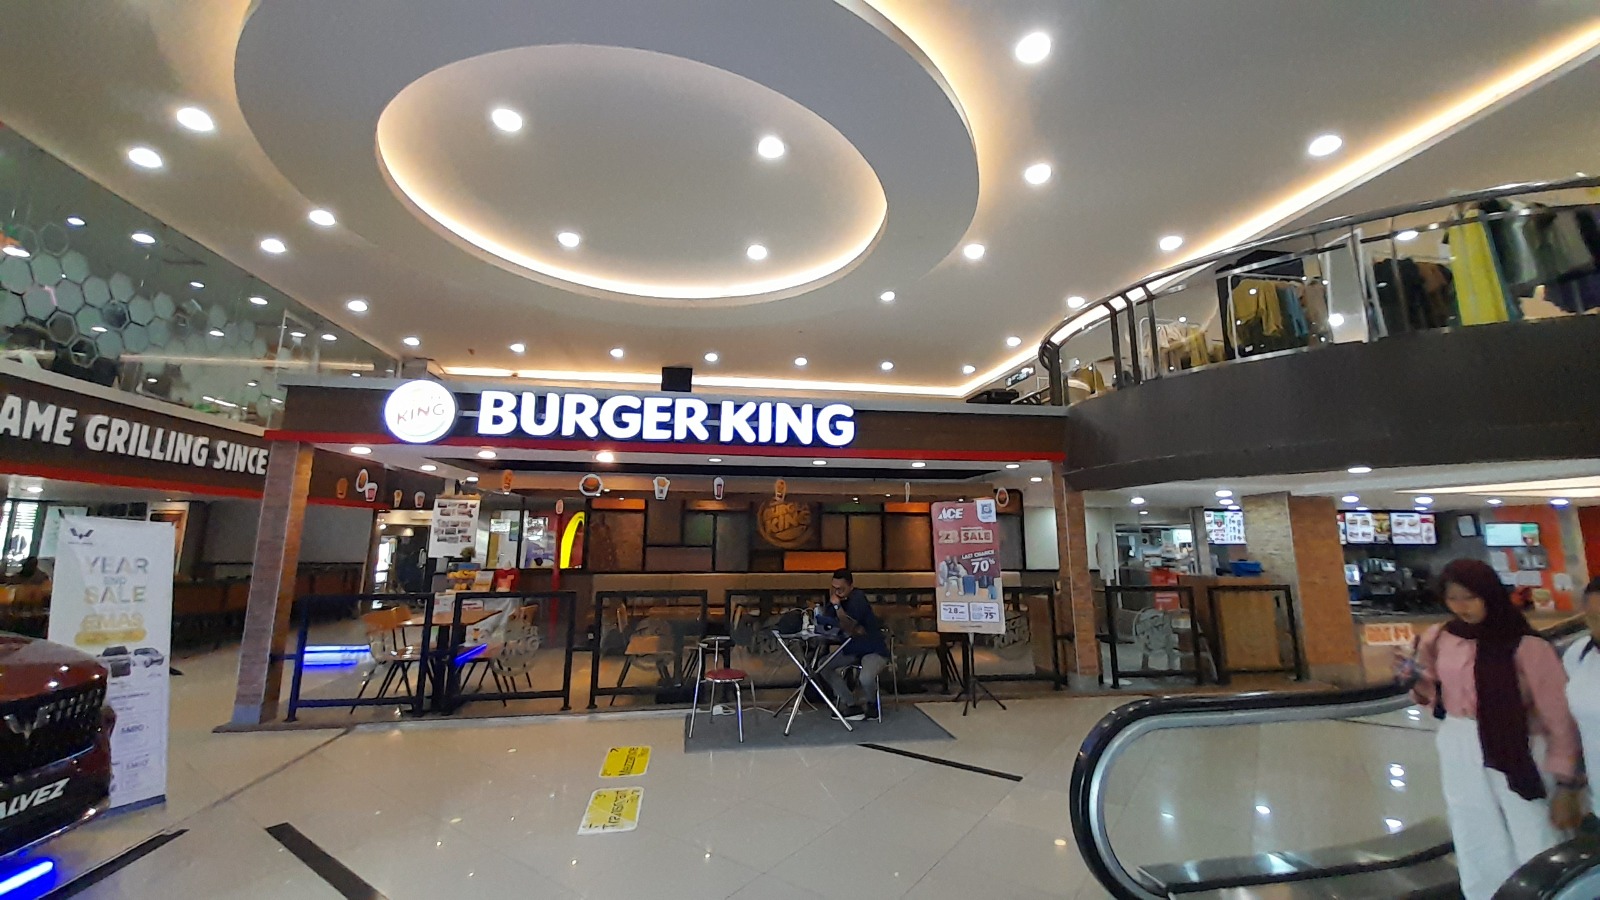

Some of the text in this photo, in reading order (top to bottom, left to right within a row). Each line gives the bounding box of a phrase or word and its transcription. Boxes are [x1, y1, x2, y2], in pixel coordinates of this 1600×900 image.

[397, 403, 445, 425] KING
[476, 389, 856, 447] BURGER KING
[0, 394, 269, 475] AME GRILLING SINCE
[938, 507, 964, 520] ACE
[962, 531, 991, 541] SALE
[85, 556, 150, 575] YEAR
[83, 585, 147, 604] SALE
